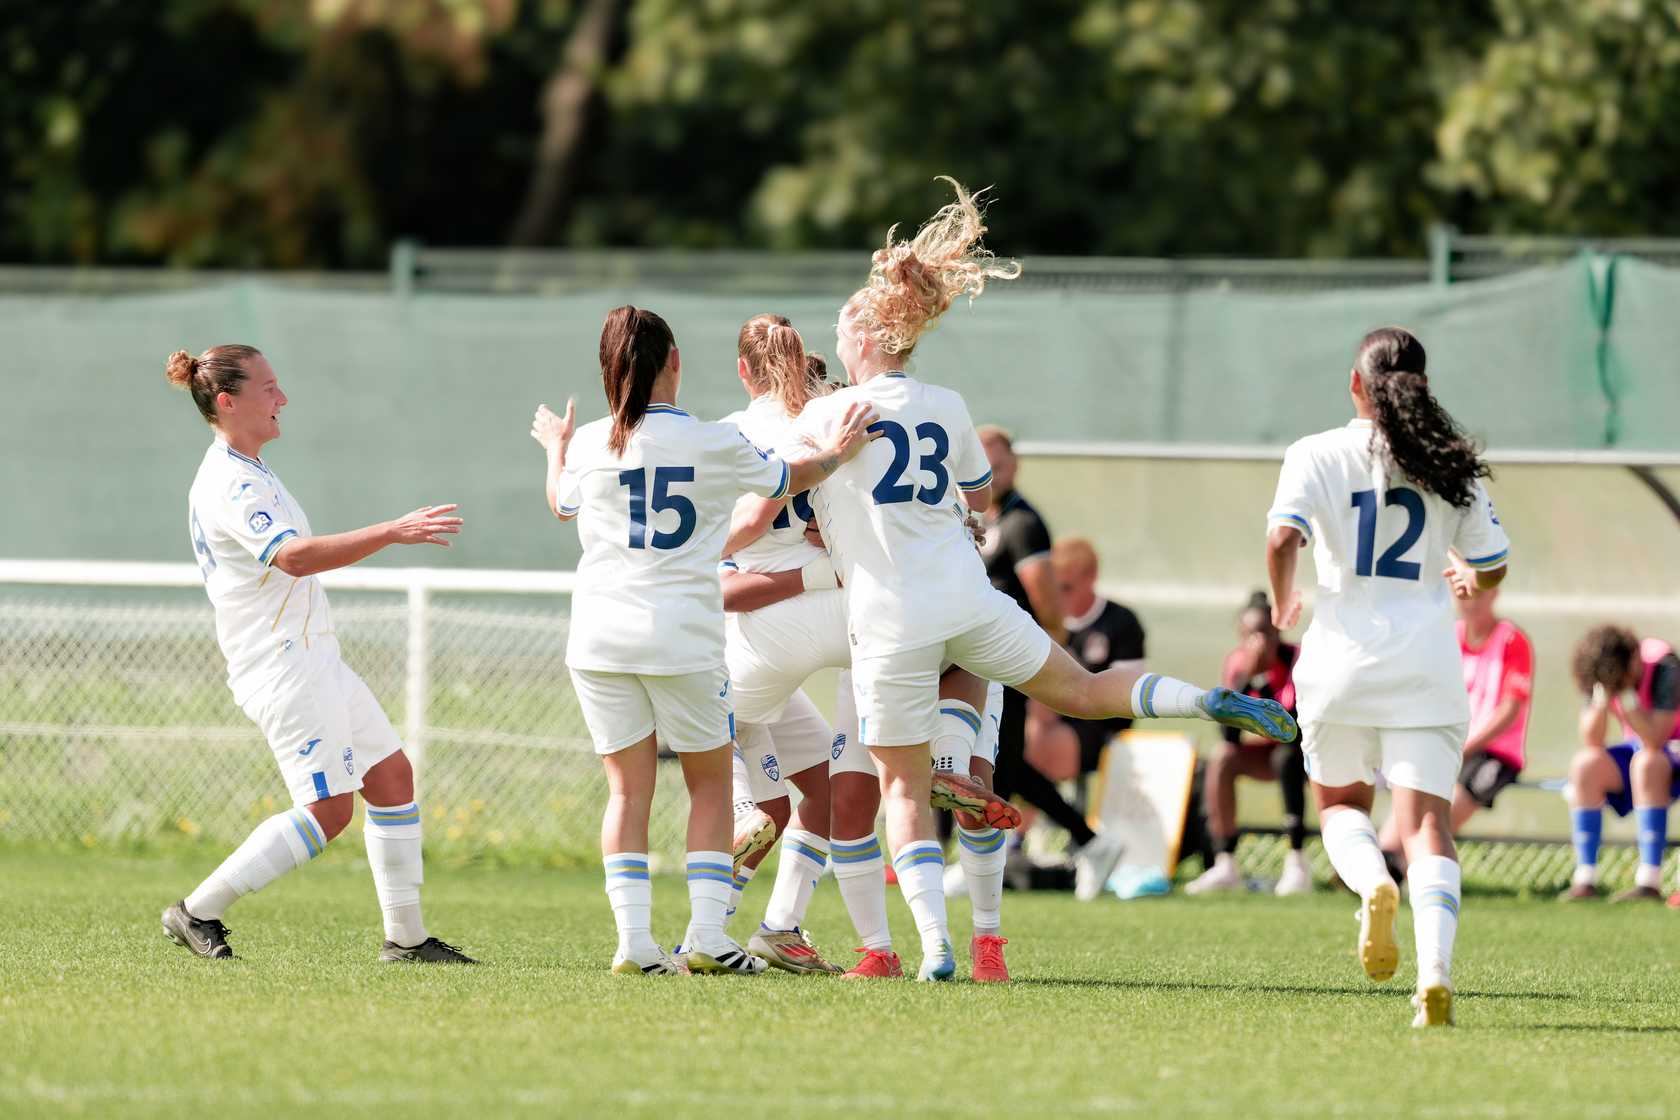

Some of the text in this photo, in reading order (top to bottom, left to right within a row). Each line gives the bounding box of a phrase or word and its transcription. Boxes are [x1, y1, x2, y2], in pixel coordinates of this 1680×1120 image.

[867, 420, 949, 506] 23
[619, 466, 696, 550] 15
[1351, 487, 1426, 580] 12
